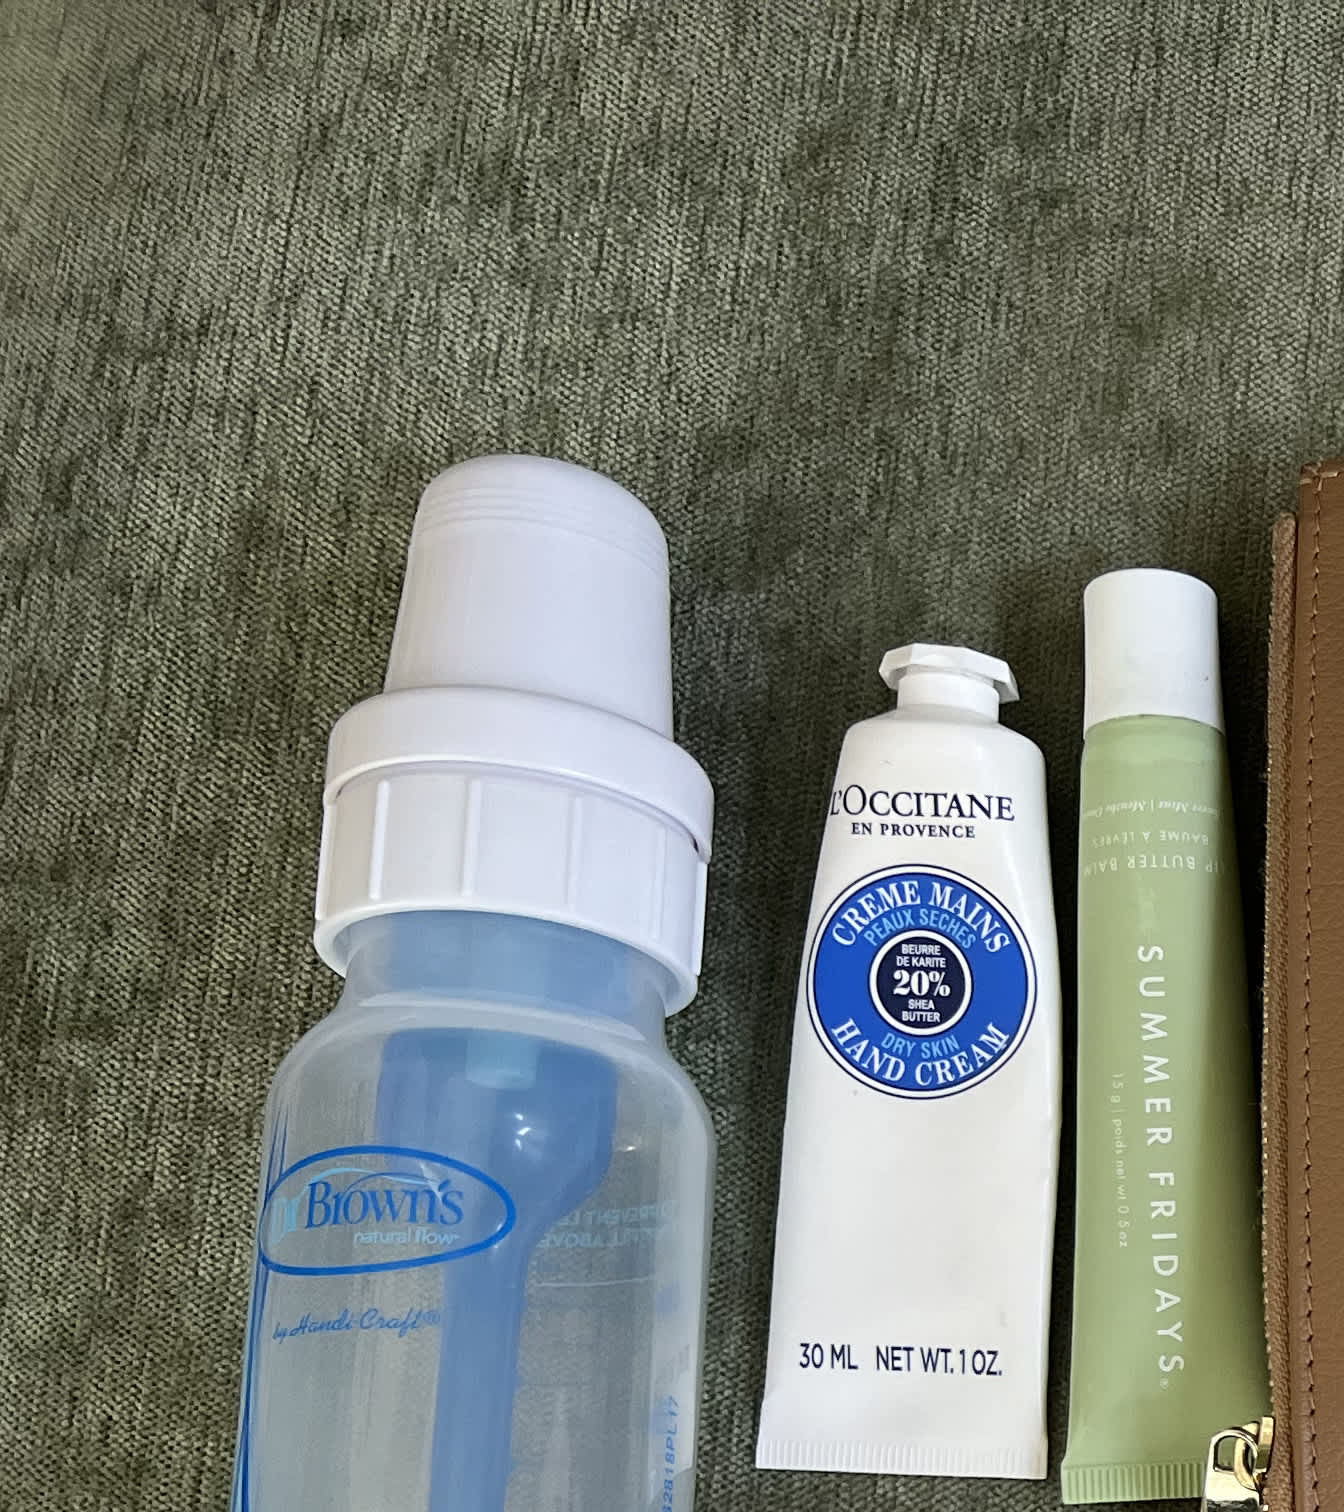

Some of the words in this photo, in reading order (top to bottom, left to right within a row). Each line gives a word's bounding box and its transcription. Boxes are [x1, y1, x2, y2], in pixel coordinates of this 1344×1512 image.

[830, 784, 1015, 821] L'OCCITANE
[851, 822, 873, 836] EN
[880, 823, 976, 838] PROVENCE
[1127, 854, 1196, 870] BUTTER
[832, 880, 921, 946] CREME
[929, 881, 1010, 953] MAINS
[863, 909, 914, 946] PEAUX
[919, 908, 977, 949] SECHES
[896, 956, 910, 968] DE
[911, 956, 946, 969] KARITE
[901, 943, 941, 956] BEURRE
[892, 970, 951, 998] 20%
[902, 1010, 941, 1023] BUTTER
[908, 999, 935, 1011] SHEA
[831, 1018, 905, 1082] HAND
[914, 1022, 1010, 1087] CREAM
[881, 1032, 913, 1058] DRY
[921, 1034, 960, 1059] SKIN
[1137, 945, 1172, 1147] SUMMER
[353, 1227, 411, 1245] natural
[799, 1343, 824, 1370] 30
[830, 1343, 859, 1370] ML
[875, 1345, 914, 1372] NET
[920, 1346, 954, 1374] WT.
[959, 1349, 966, 1374] 1
[971, 1350, 1003, 1377] OZ.
